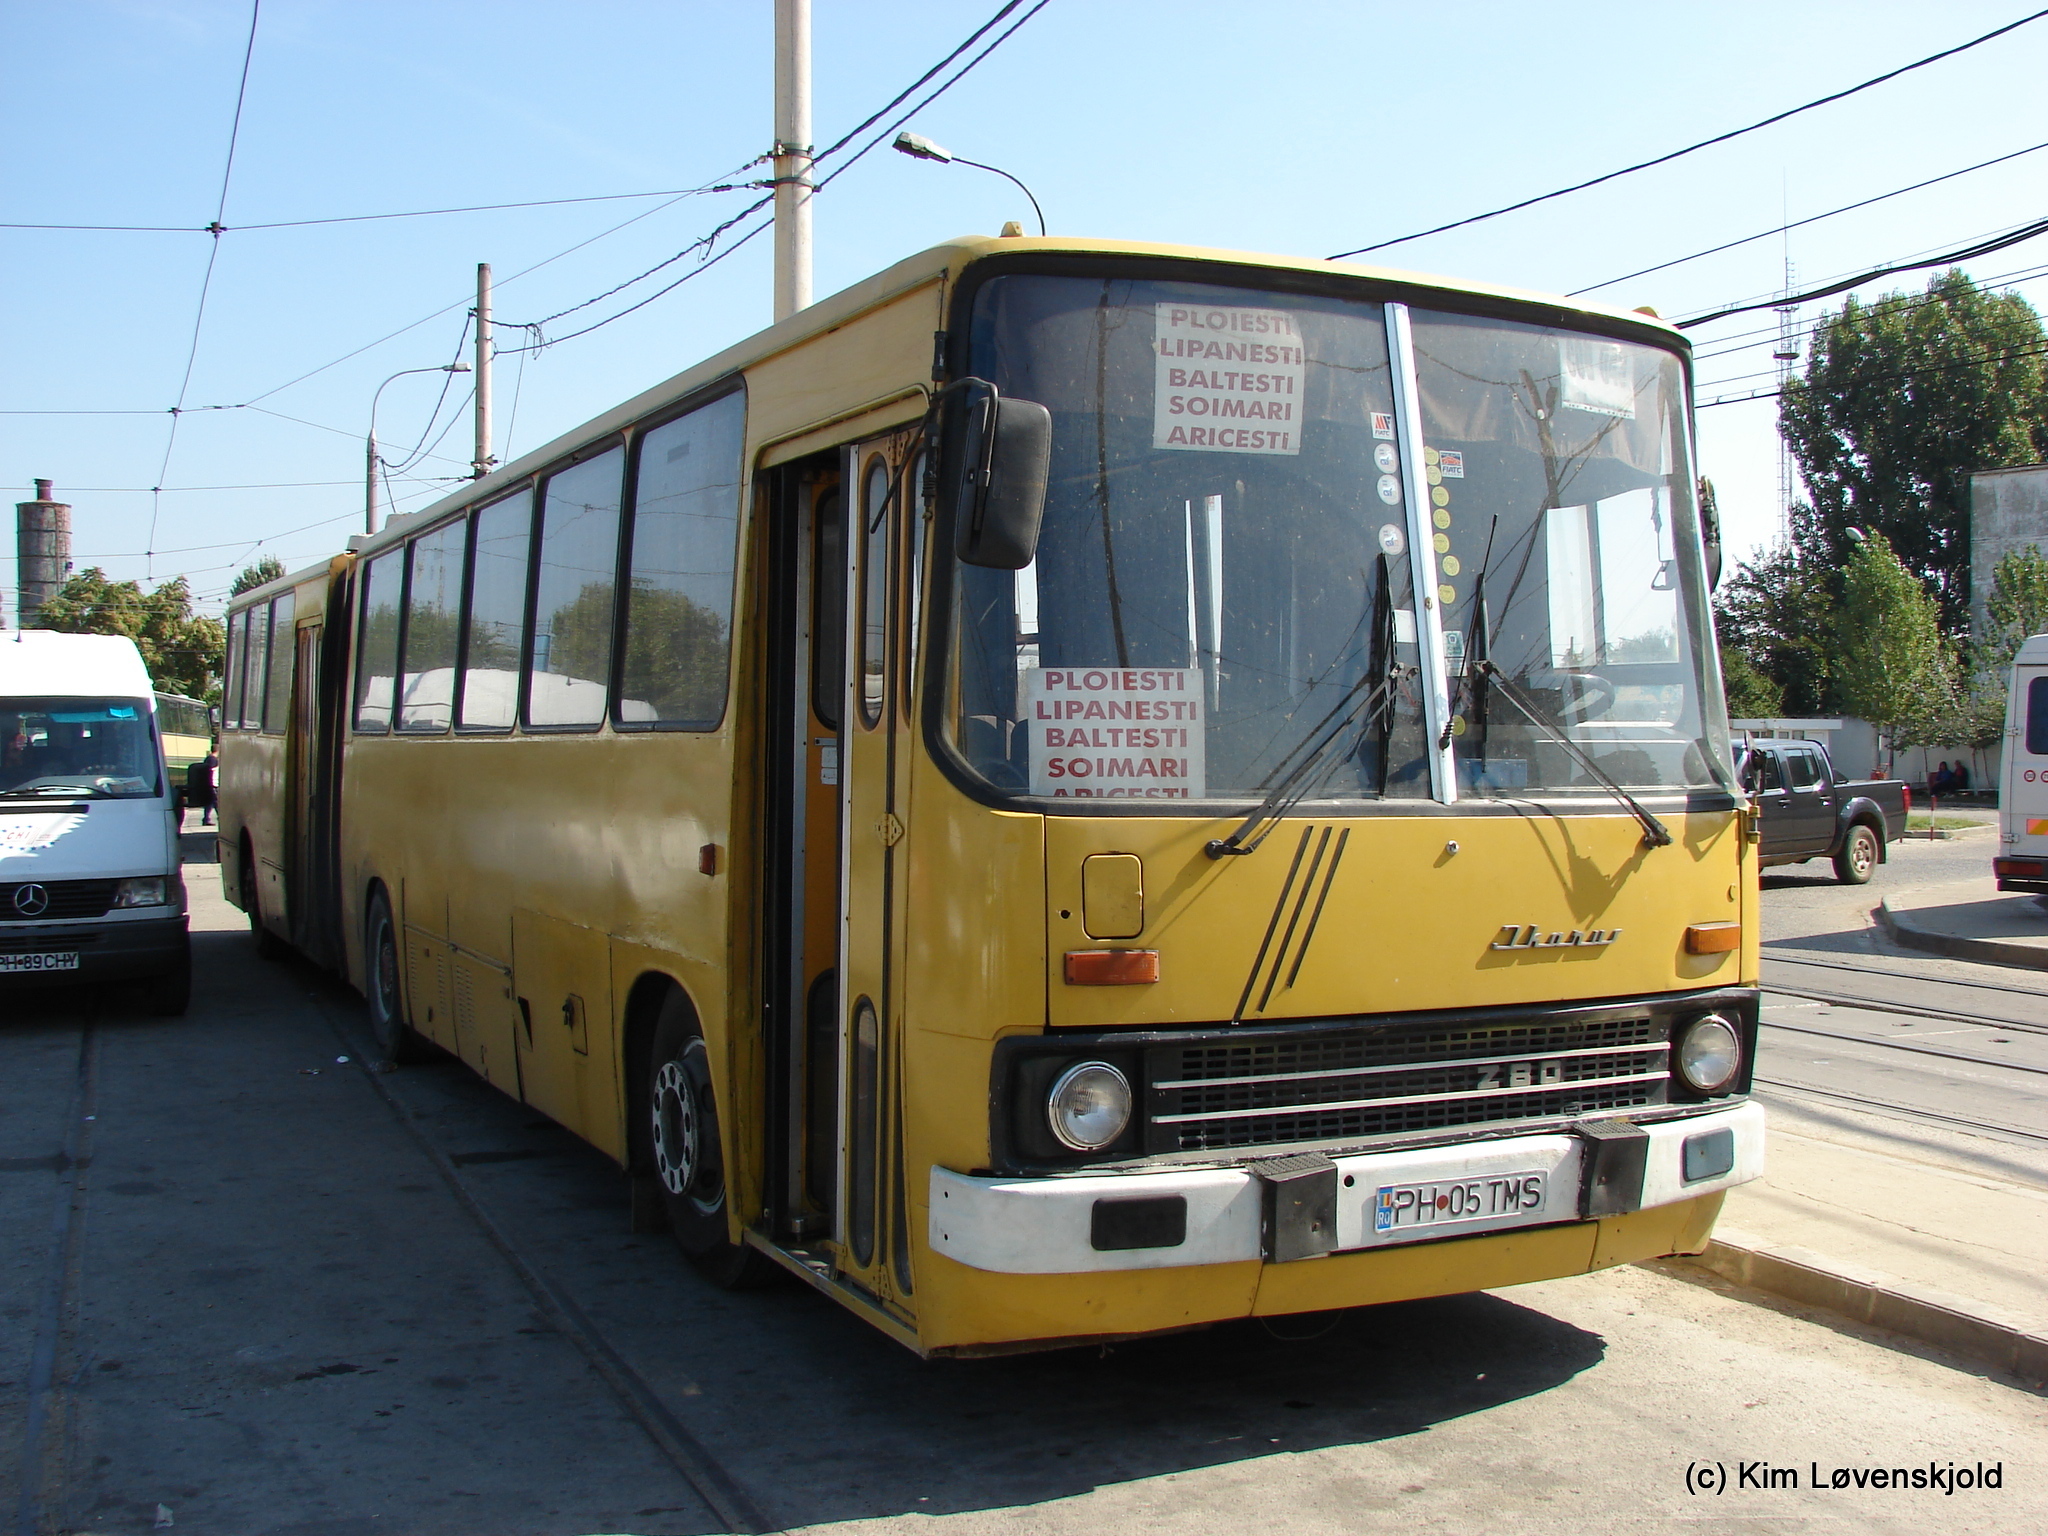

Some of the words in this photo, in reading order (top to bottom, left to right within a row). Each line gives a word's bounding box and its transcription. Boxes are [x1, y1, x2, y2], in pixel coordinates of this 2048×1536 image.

[1170, 309, 1292, 335] PLOIESTI
[1160, 338, 1302, 365] LIPANESTI
[1169, 368, 1294, 394] BALTESTI
[1169, 395, 1292, 421] SOIMARI
[1167, 425, 1290, 450] ARICESTI
[1045, 671, 1184, 691] PLOIESTI
[1036, 700, 1197, 720] LIPANESTI
[1046, 728, 1187, 748] BALTESTI
[1048, 757, 1188, 778] SOIMARI
[23, 954, 43, 969] 89
[44, 952, 78, 968] CHY
[1395, 1186, 1439, 1224] PH
[1450, 1181, 1482, 1215] 05
[1487, 1175, 1542, 1213] TMS
[1378, 1211, 1390, 1225] RO
